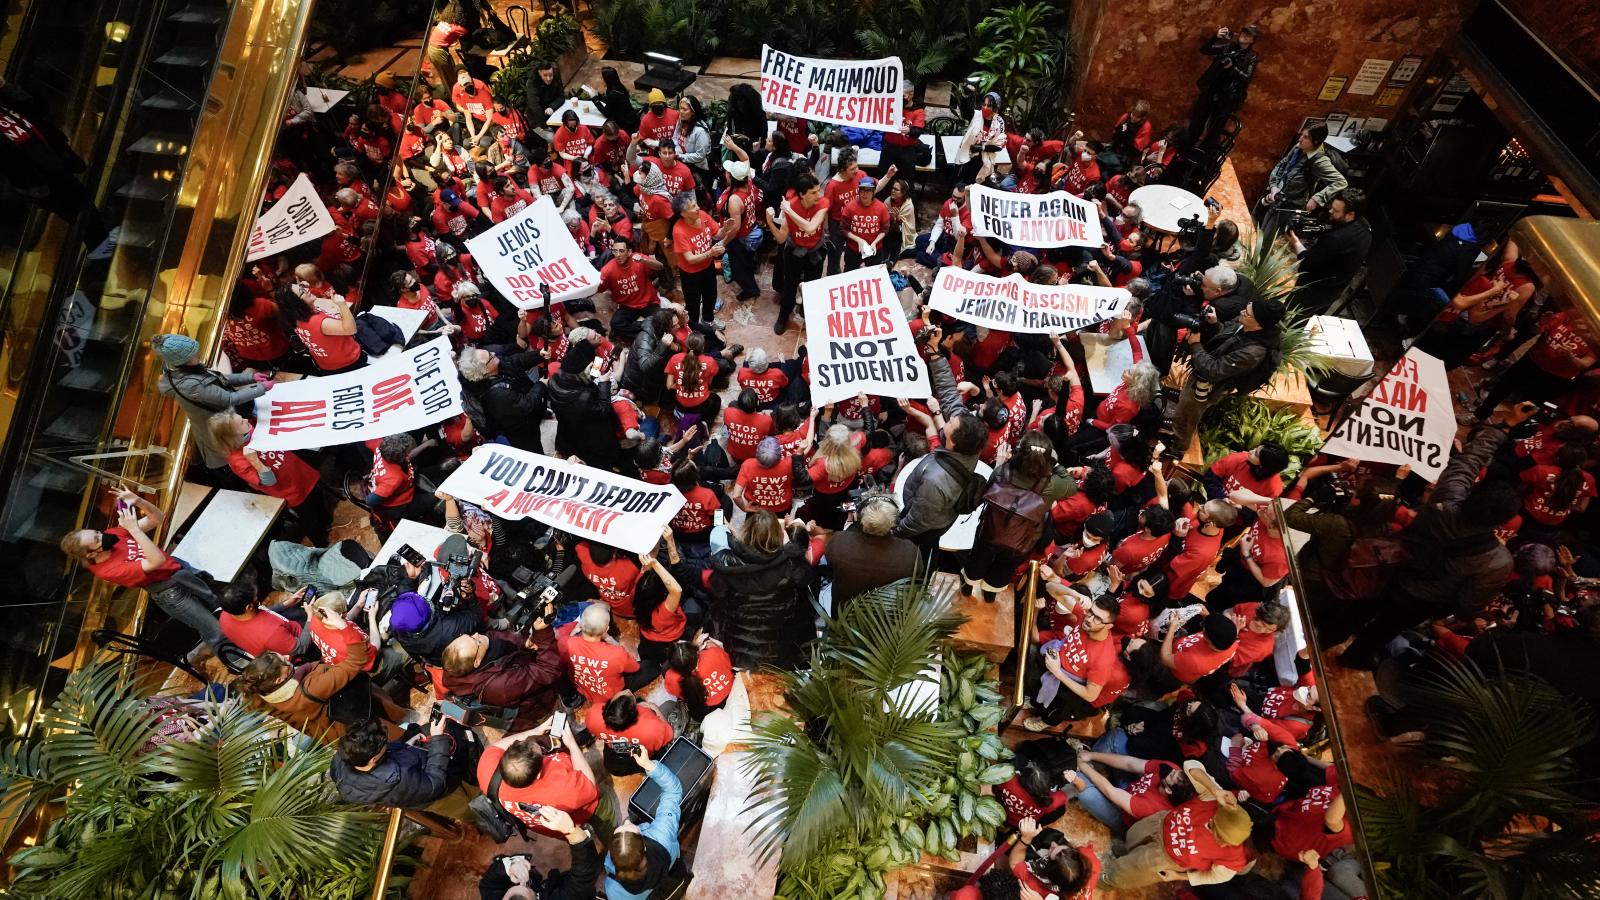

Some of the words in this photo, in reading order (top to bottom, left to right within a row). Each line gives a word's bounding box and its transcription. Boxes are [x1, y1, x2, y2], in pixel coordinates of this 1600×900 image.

[762, 48, 805, 85] FREE
[808, 66, 898, 94] MAHMOUD
[760, 78, 799, 111] FREE
[803, 92, 896, 126] PALESTINE
[1344, 120, 1357, 133] A
[567, 138, 586, 146] STOP
[662, 173, 672, 181] OT
[839, 190, 854, 200] NOT
[980, 195, 1031, 218] NEVER
[1039, 199, 1087, 223] AGAIN
[497, 218, 541, 257] JEWS
[691, 234, 705, 246] NOT
[984, 215, 1013, 240] FOR
[1020, 220, 1087, 242] ANYONE
[697, 234, 711, 248] OUR
[513, 244, 544, 272] SAY
[505, 275, 535, 289] DO
[536, 258, 575, 286] NOT
[829, 278, 883, 311] FIGHT
[943, 274, 1019, 303] OPPOSING
[1023, 290, 1088, 313] FASCISM
[827, 307, 894, 338] NAZIS
[956, 298, 1017, 324] JEWISH
[829, 337, 898, 360] NOT
[818, 355, 919, 388] STUDENTS
[743, 379, 774, 388] JEWS
[755, 387, 771, 395] AY
[332, 385, 365, 417] FACE
[420, 380, 452, 415] FOR
[850, 398, 876, 407] JES
[268, 400, 327, 436] ALL
[729, 422, 758, 434] STOP
[728, 429, 760, 441] ARMING
[273, 450, 286, 470] NA
[480, 451, 529, 487] YOU
[523, 465, 589, 499] CAN'T
[586, 481, 672, 514] DEPORT
[752, 475, 788, 484] JEWS
[756, 483, 785, 491] SAY
[753, 489, 785, 497] STOP
[484, 489, 510, 507] A
[503, 492, 624, 535] MOVEMENT
[684, 502, 702, 510] WS
[1067, 633, 1080, 664] OUR
[1073, 625, 1083, 646] NOT
[1079, 649, 1088, 664] IN
[570, 654, 609, 669] JEWS
[574, 664, 603, 677] SAY
[703, 671, 718, 685] OP
[709, 674, 726, 690] ING
[710, 679, 730, 697] AEL
[599, 732, 640, 744] STOP
[1002, 788, 1024, 805] NOT
[1029, 805, 1041, 815] IN
[1183, 807, 1193, 832] NOT
[1170, 812, 1183, 857] AME
[1176, 814, 1186, 849] OUR
[1186, 839, 1199, 855] IN
